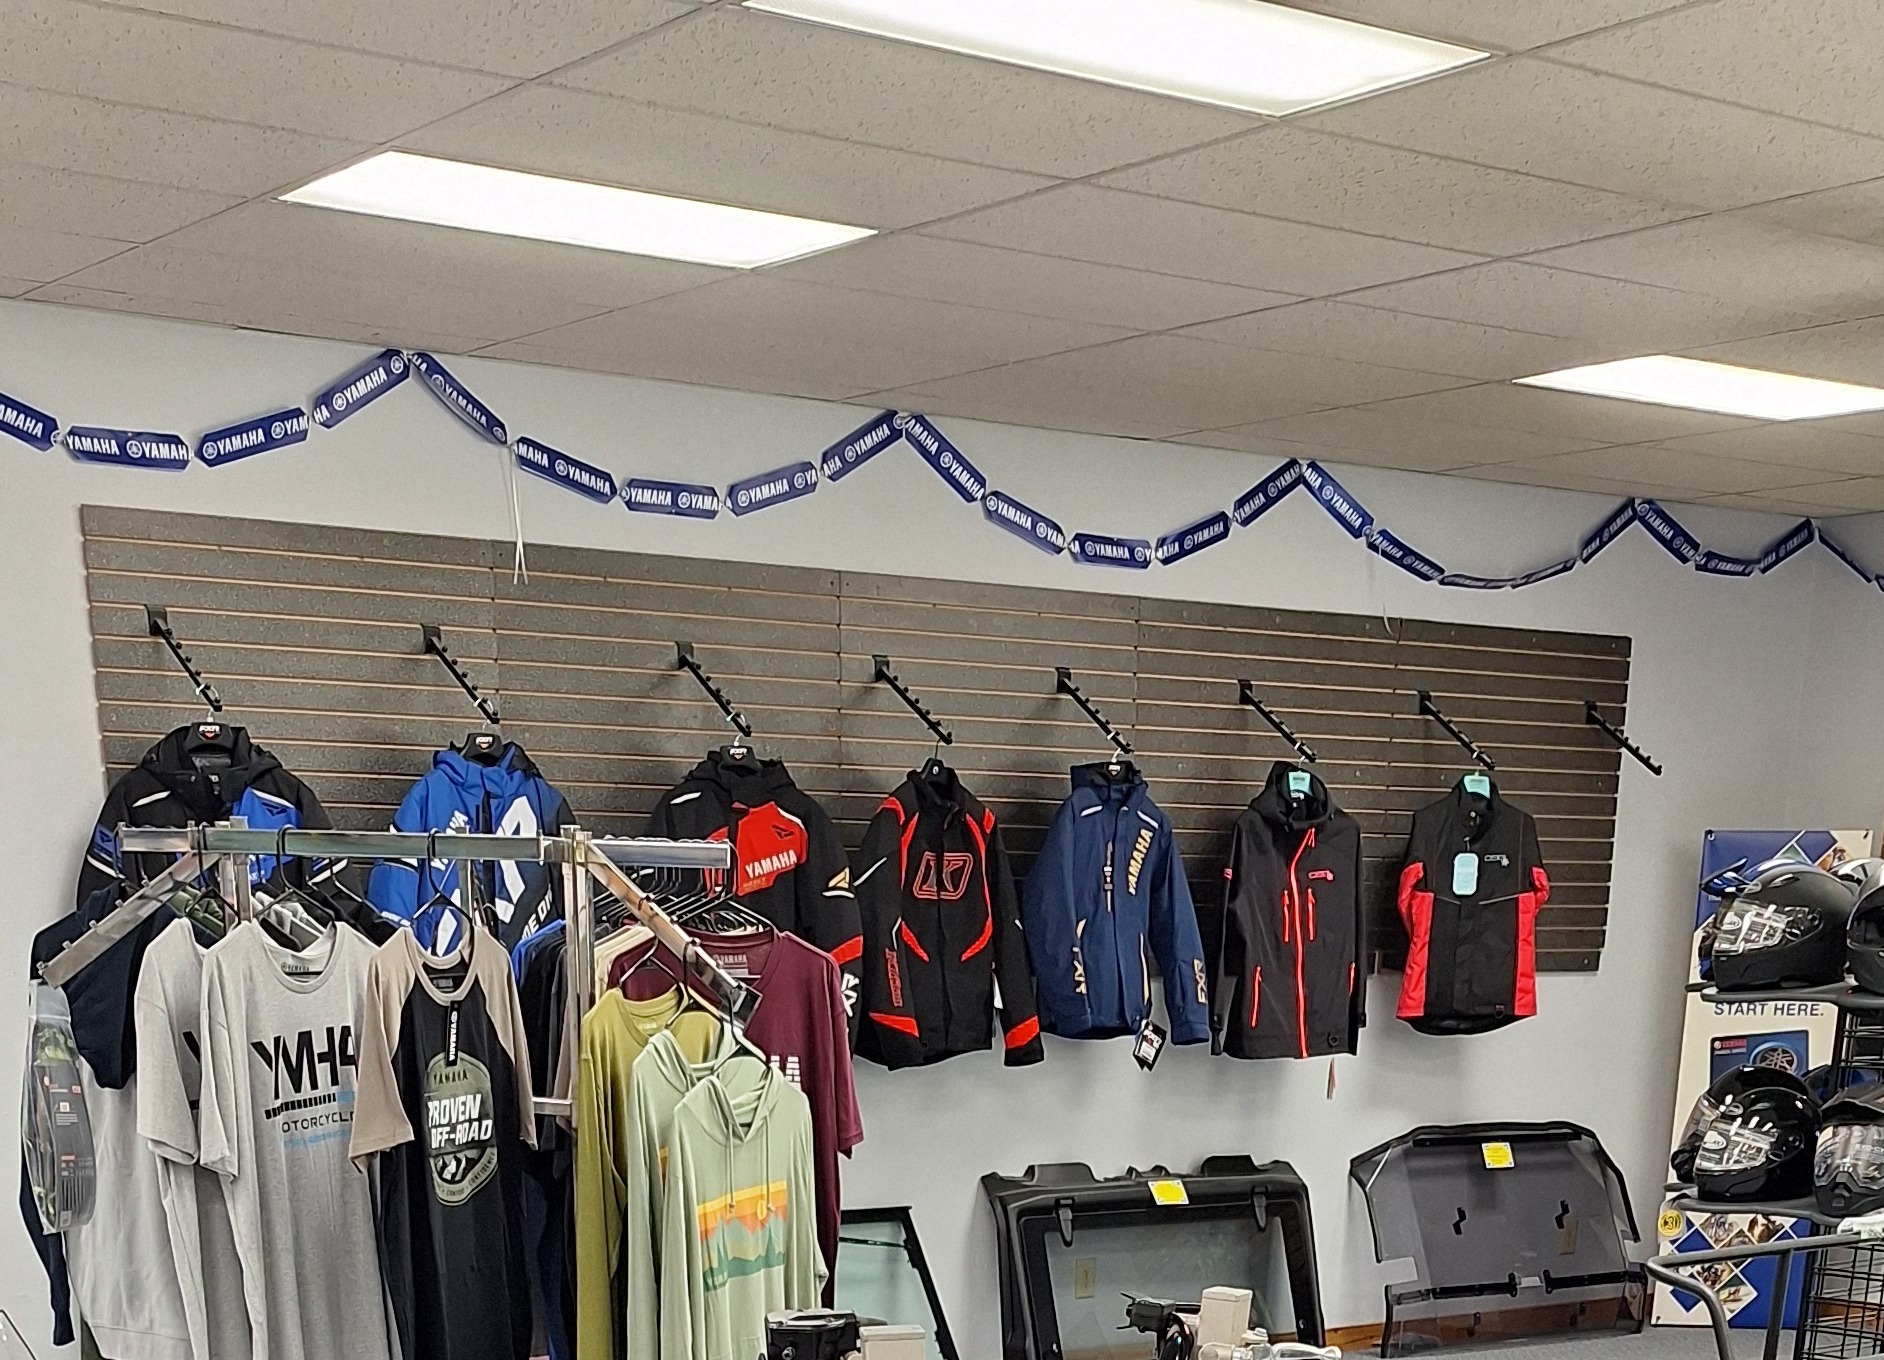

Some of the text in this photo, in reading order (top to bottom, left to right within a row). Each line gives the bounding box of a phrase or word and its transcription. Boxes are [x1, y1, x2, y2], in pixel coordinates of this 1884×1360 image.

[343, 366, 387, 404] YAMAHA
[444, 384, 488, 428] YAMAHA
[66, 434, 120, 456] YAMAHA
[217, 428, 265, 455] YAMAHA
[854, 423, 891, 455] YAMAHA
[567, 464, 611, 496] YAMAHA
[750, 478, 789, 503] YAMAHA
[949, 461, 985, 501] YAMAHA
[631, 487, 672, 506] YAMAHA
[1234, 492, 1267, 523] YAMAHA
[1330, 493, 1364, 530] YAMAHA
[997, 500, 1032, 531] YAMAHA
[1645, 510, 1675, 541] YAMAHA
[1193, 520, 1225, 545] YAMAHA
[1370, 533, 1404, 559] YAMAHA
[1094, 546, 1131, 560] YAMAHA
[745, 849, 797, 879] YAMAHA
[1127, 829, 1154, 896] YAMAHA
[1714, 1002, 1824, 1017] START HERE.
[428, 1093, 481, 1128] PROVEN
[431, 1119, 493, 1149] OFF-ROAD
